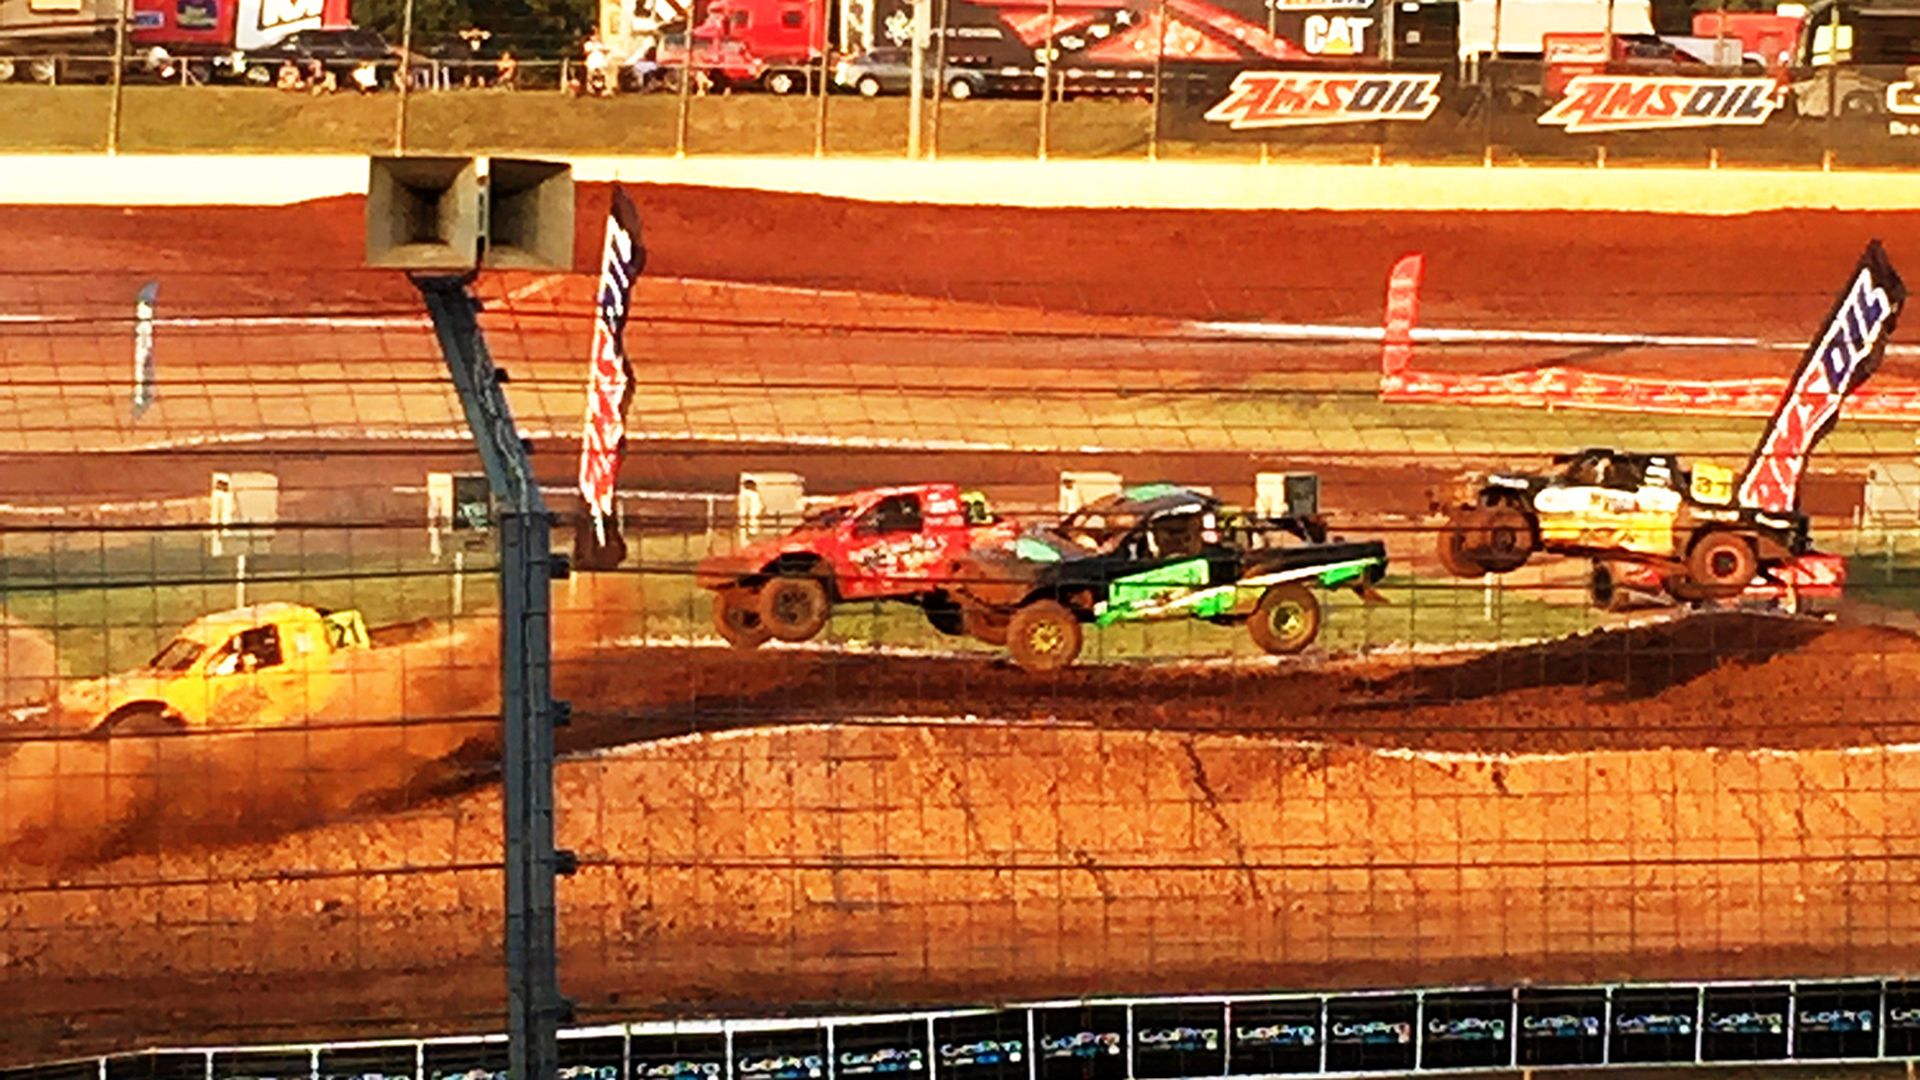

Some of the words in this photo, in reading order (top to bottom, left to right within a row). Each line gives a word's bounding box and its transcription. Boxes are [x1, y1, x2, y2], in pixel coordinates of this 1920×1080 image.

[1304, 14, 1375, 54] CAT
[1212, 73, 1437, 127] AMSOIL
[1543, 77, 1777, 131] AMSOIL
